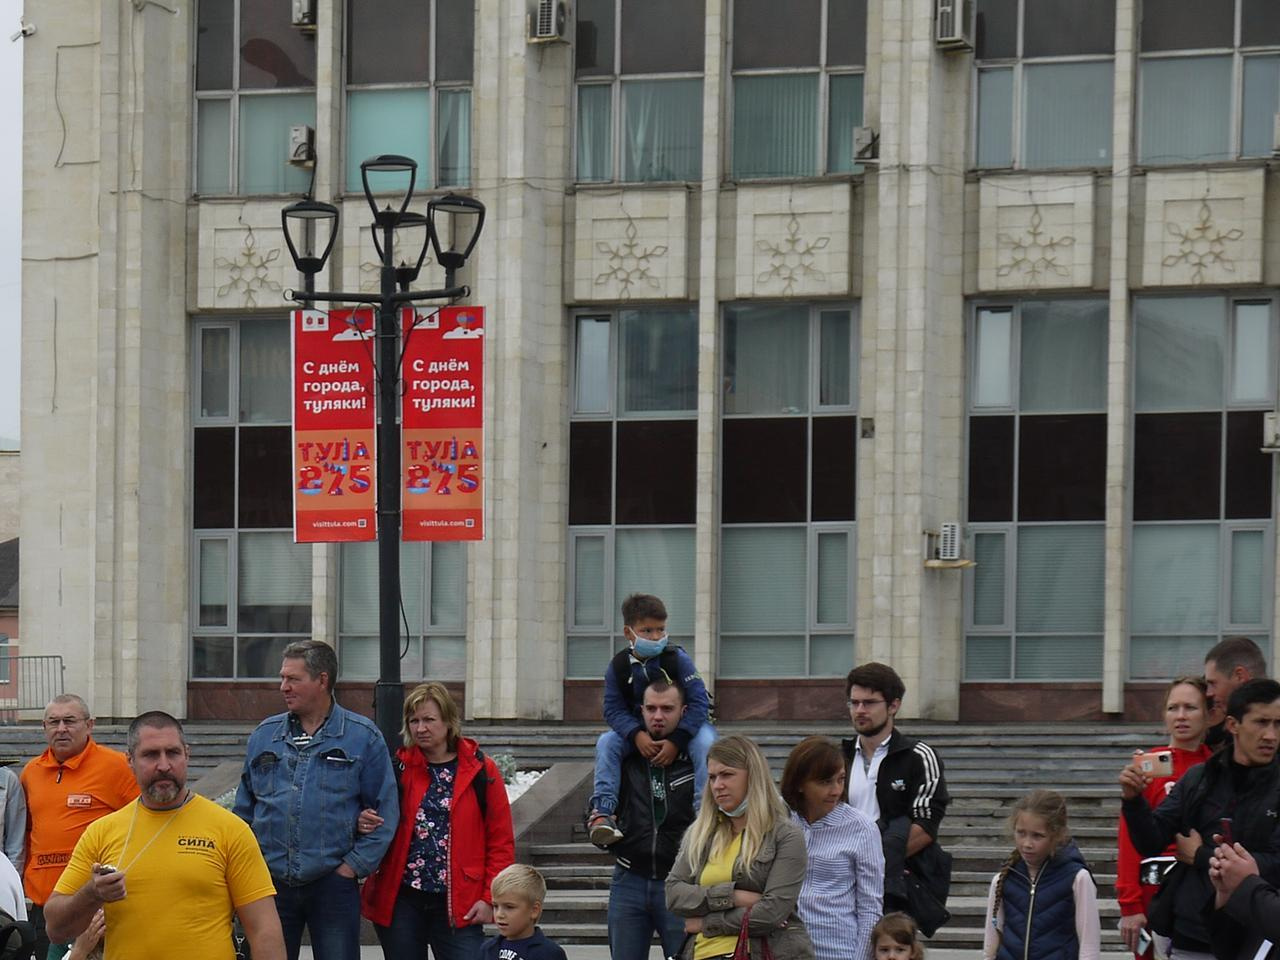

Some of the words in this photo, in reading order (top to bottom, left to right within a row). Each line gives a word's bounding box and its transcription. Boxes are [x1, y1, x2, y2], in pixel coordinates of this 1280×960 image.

[303, 363, 314, 375] С
[319, 360, 360, 377] днём
[413, 360, 424, 372] С
[428, 358, 469, 375] днём
[303, 380, 365, 396] города,
[413, 378, 475, 394] города,
[303, 397, 366, 413] туляки!
[413, 395, 476, 412] туляки!
[298, 437, 370, 463] ТУЛА
[406, 436, 479, 462] ТУЛА
[297, 463, 370, 496] 875
[405, 461, 479, 495] 875
[178, 838, 215, 849] СИЛА
